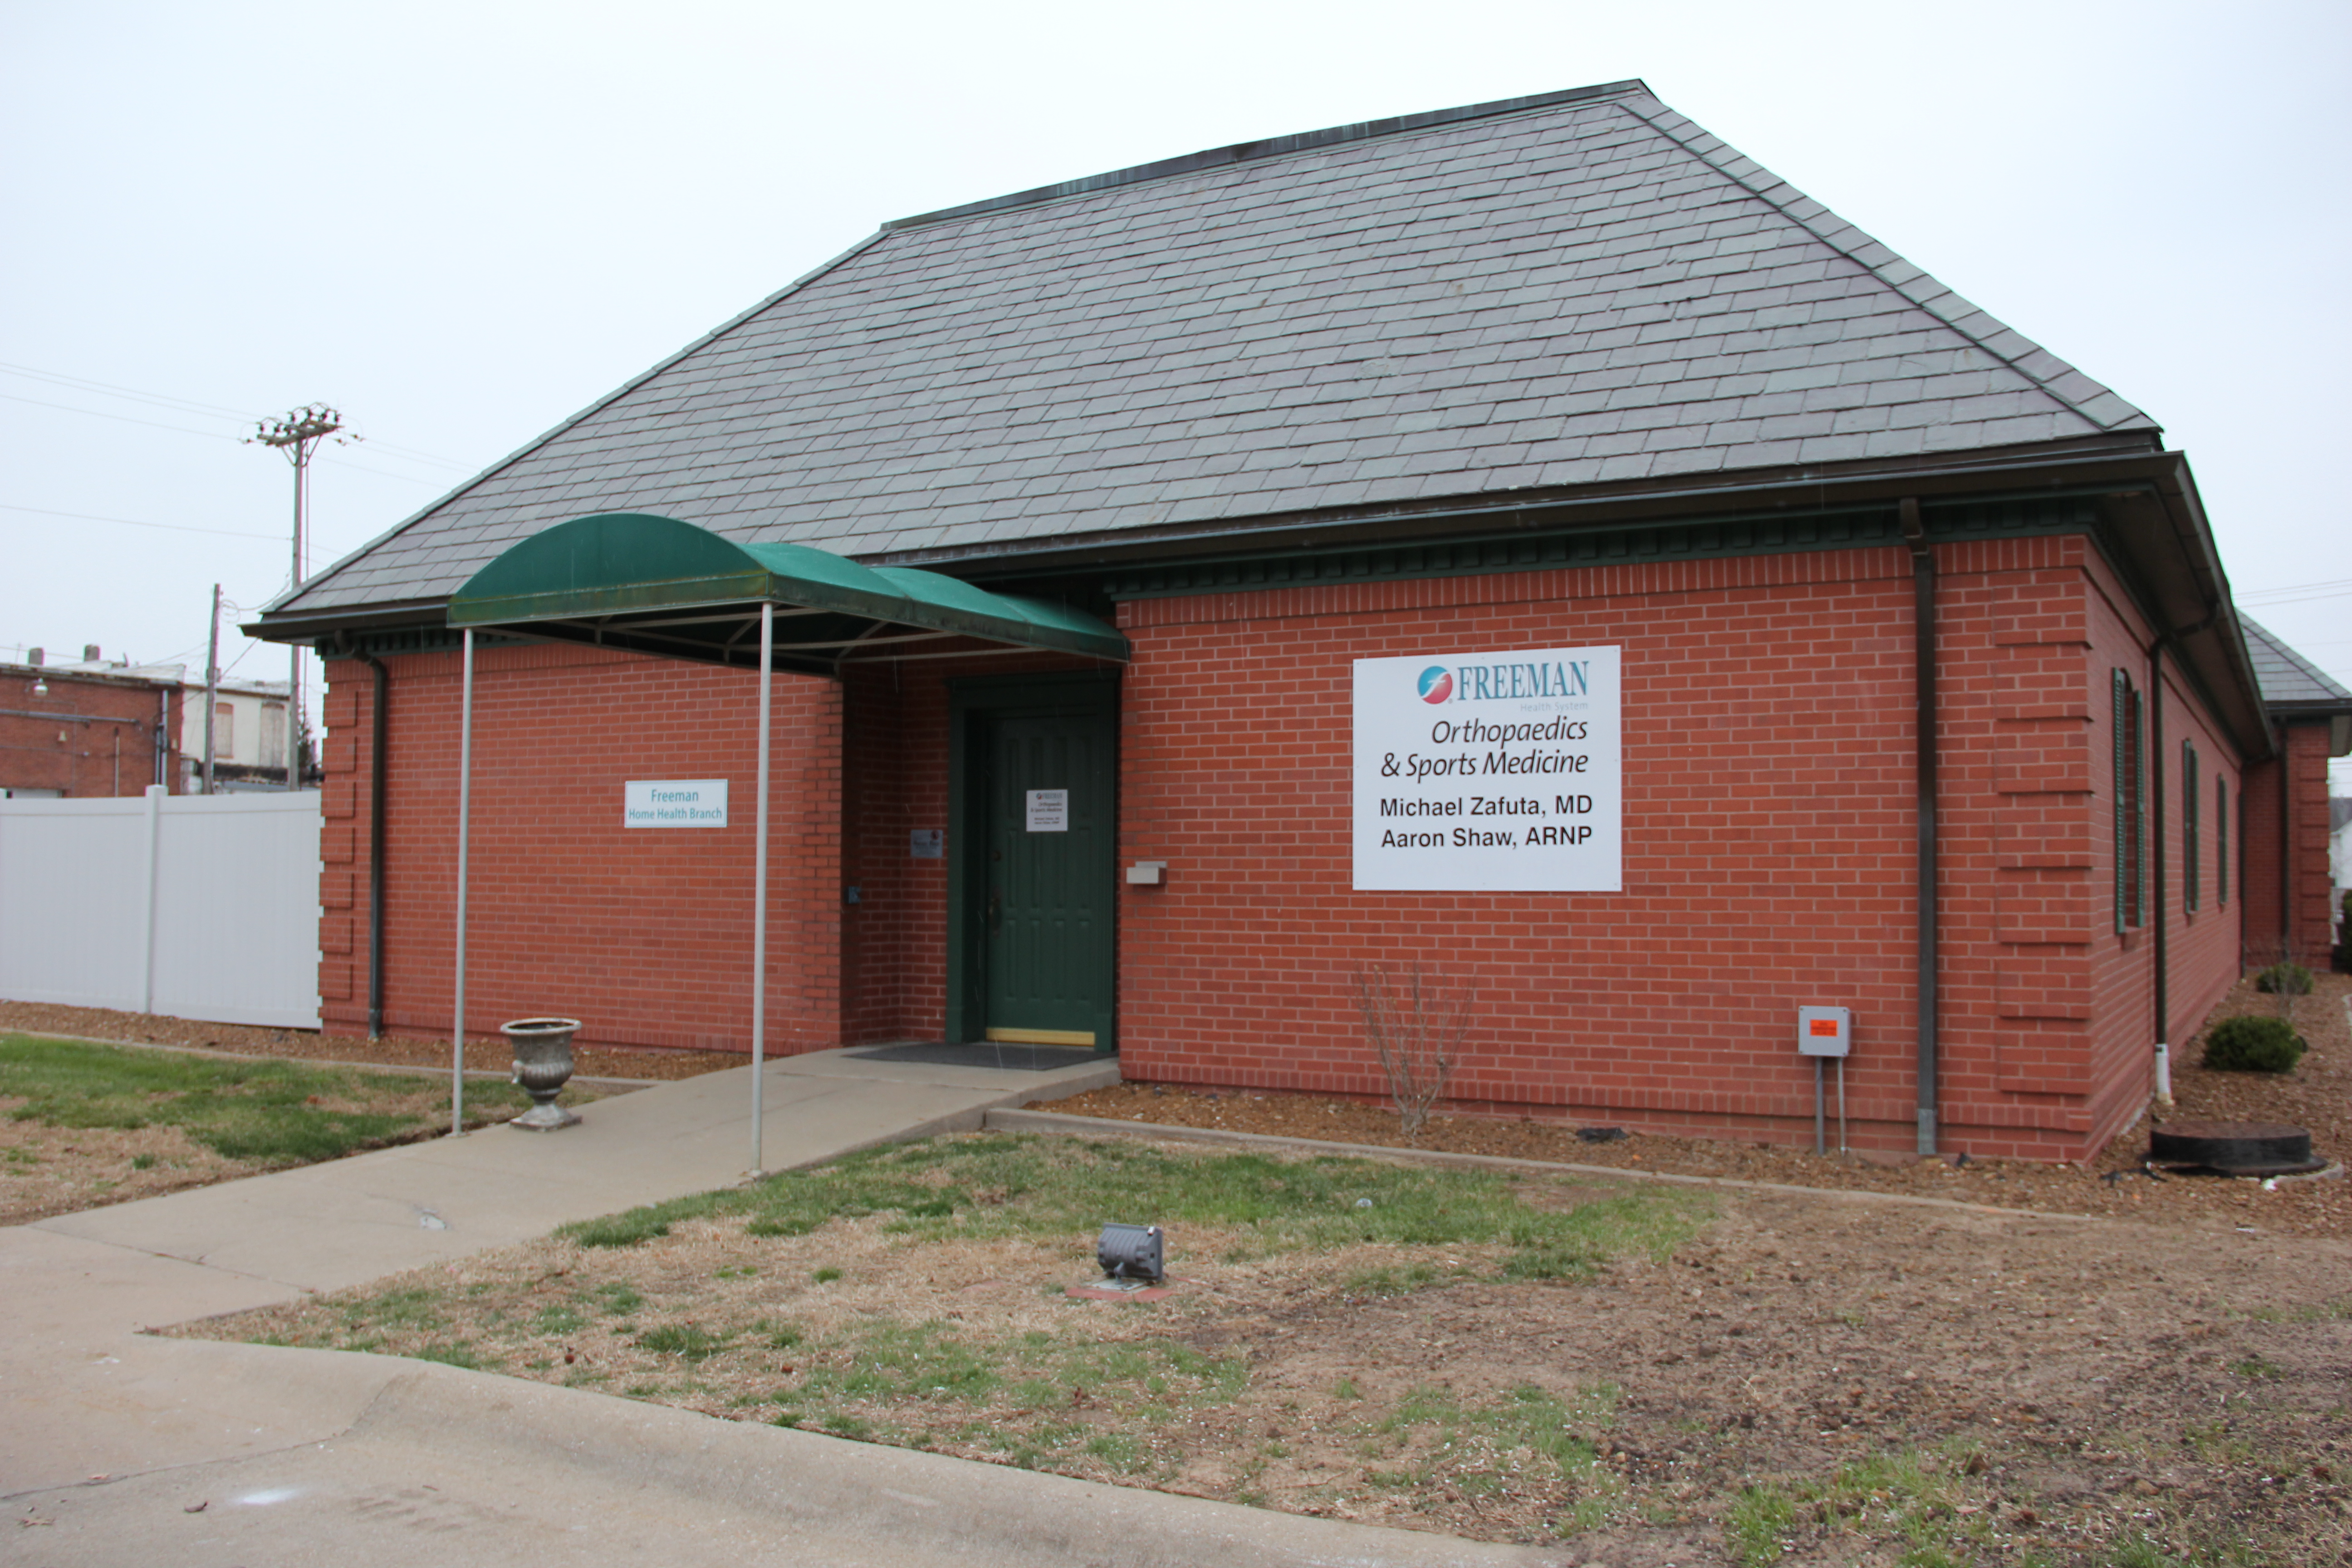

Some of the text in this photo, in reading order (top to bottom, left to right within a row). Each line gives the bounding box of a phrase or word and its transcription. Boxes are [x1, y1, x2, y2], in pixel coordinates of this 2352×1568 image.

[1457, 661, 1589, 701] FREEMAN
[1520, 702, 1588, 713] Health System
[1432, 715, 1588, 749] Orthopaedics
[1381, 749, 1589, 784] & Sports Medicine
[651, 789, 699, 802] Freeman
[1381, 794, 1592, 818] Michael Zafuta, MD
[628, 807, 722, 819] Home Health Branch
[1381, 826, 1592, 850] Aaron Shaw, ARNP
